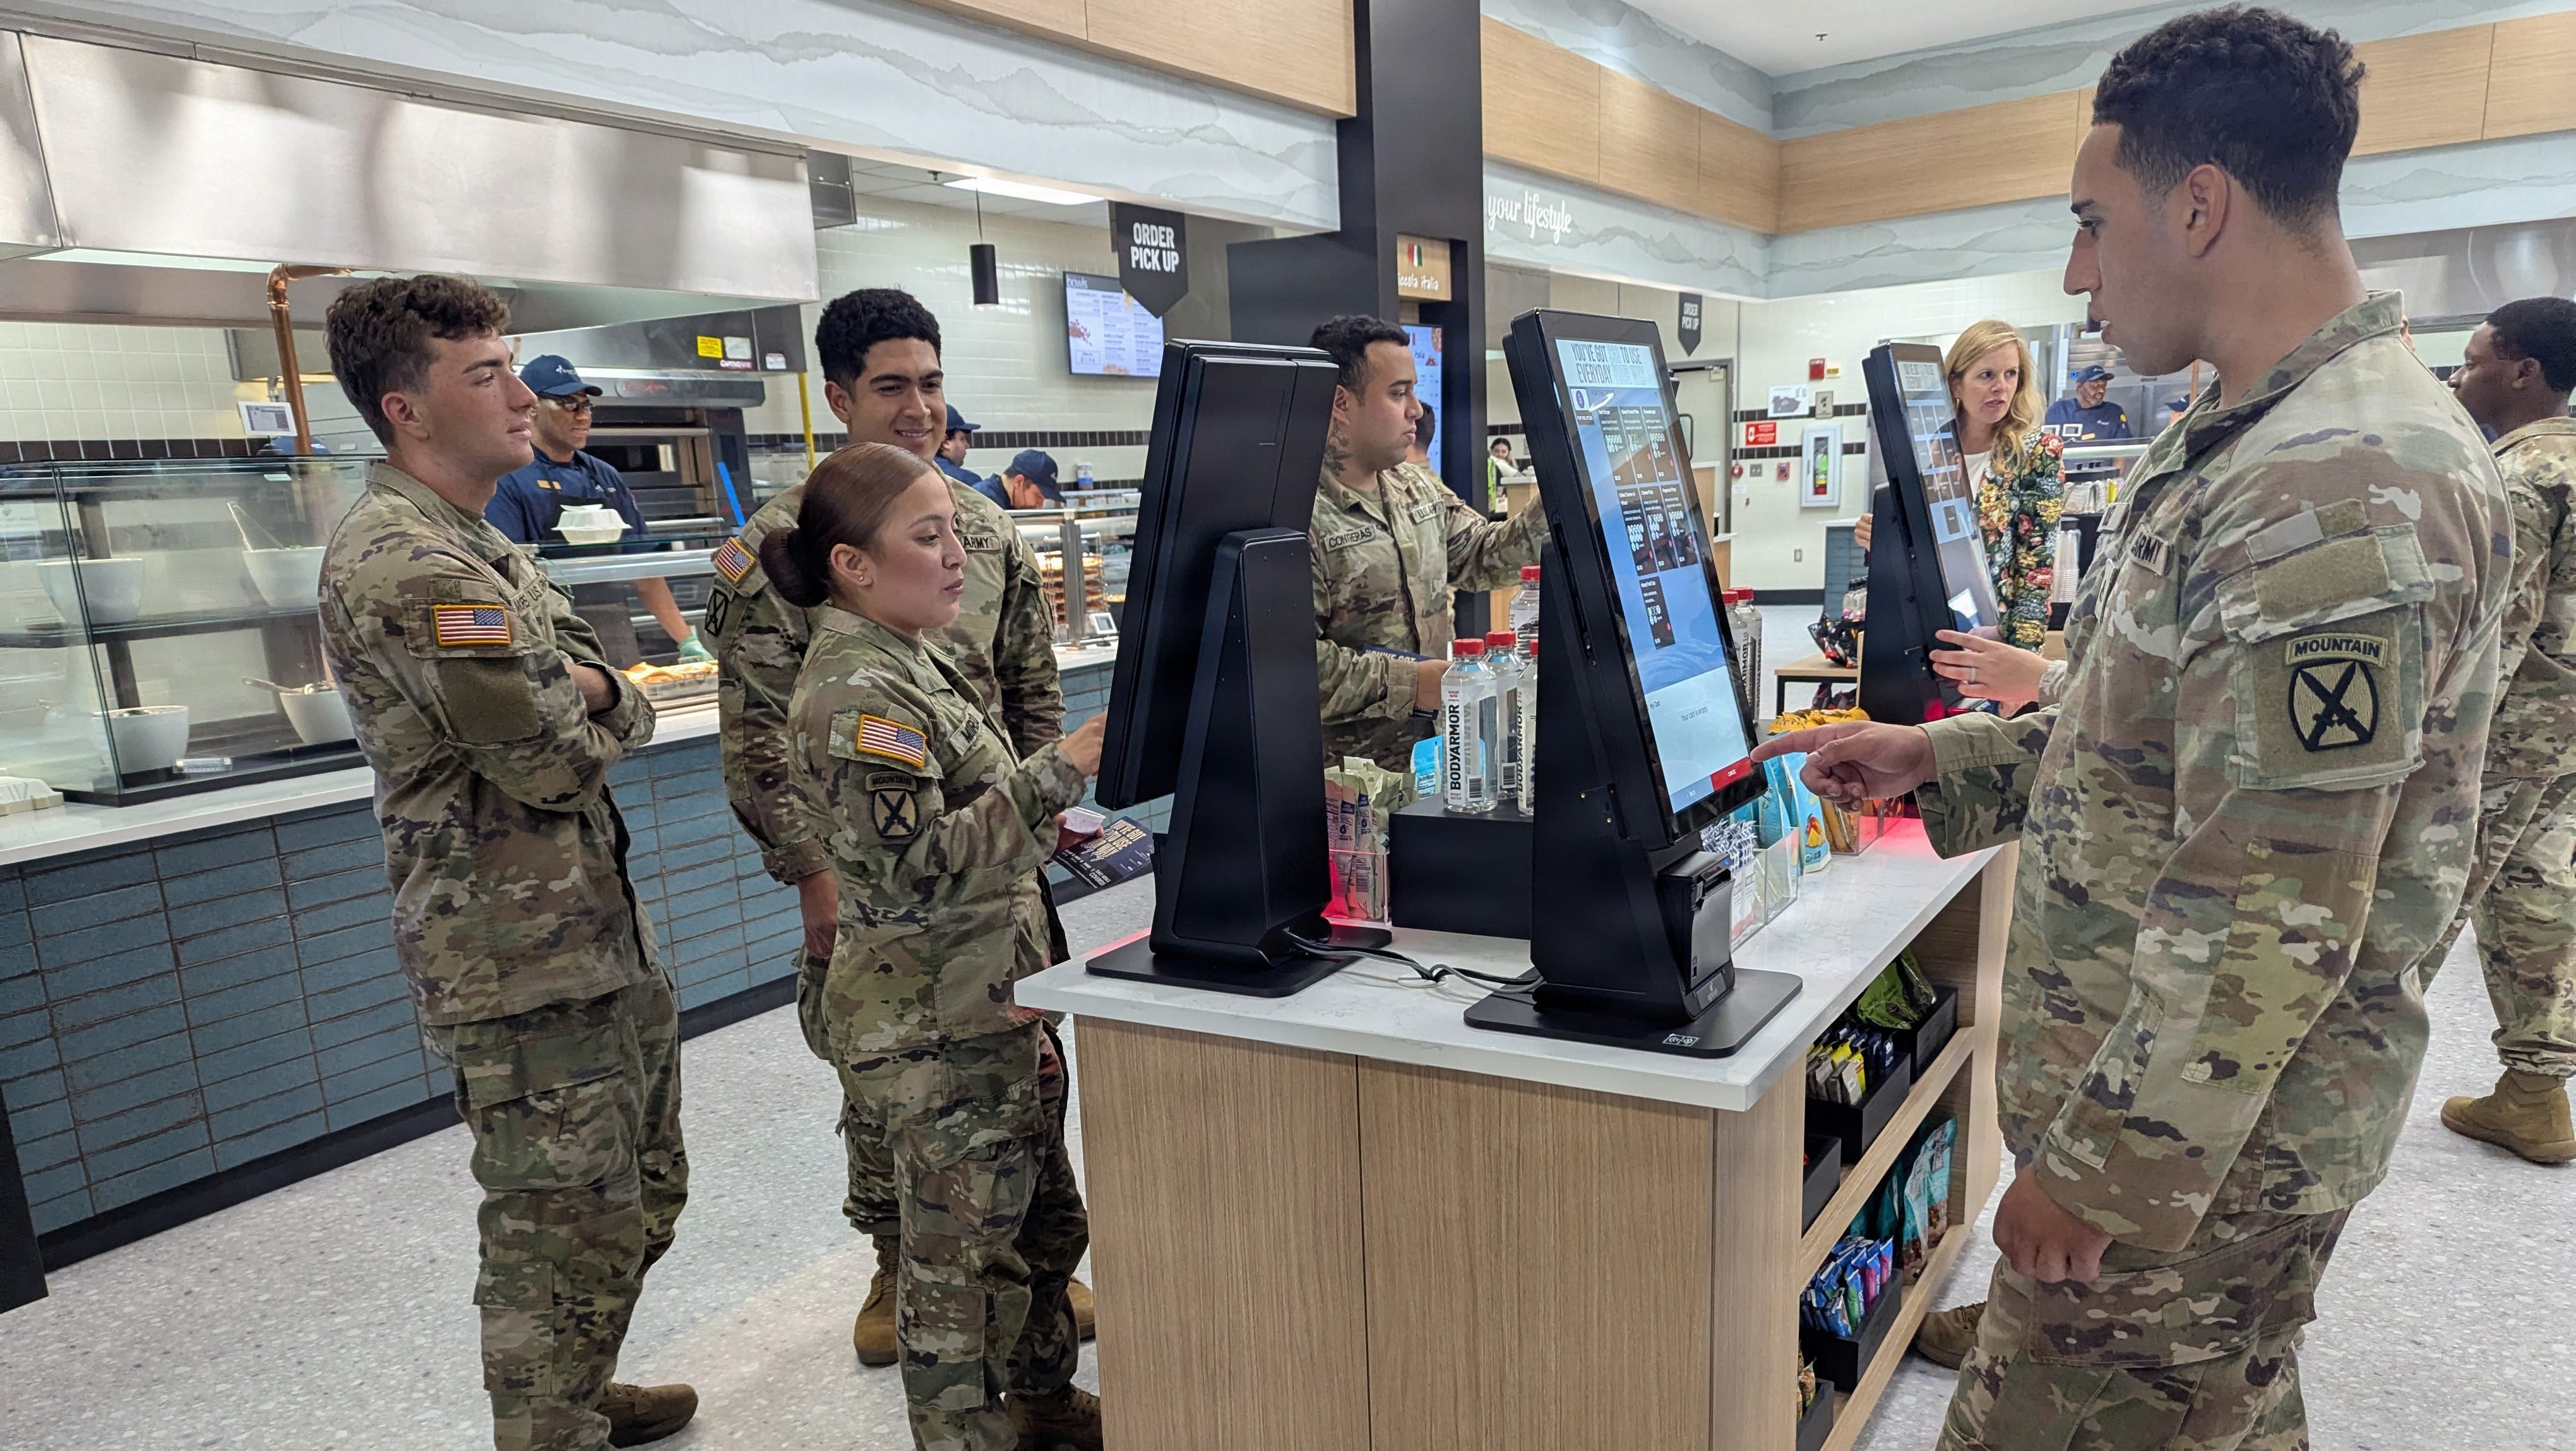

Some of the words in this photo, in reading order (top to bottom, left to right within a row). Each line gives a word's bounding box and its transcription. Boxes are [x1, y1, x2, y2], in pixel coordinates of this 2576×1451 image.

[1488, 195, 1521, 231] your
[1524, 191, 1571, 244] lifestyle
[1133, 222, 1175, 249] ORDER
[1130, 246, 1161, 271] PICK
[1162, 250, 1179, 273] UP
[1398, 272, 1418, 289] iccola
[1420, 274, 1439, 291] italia
[1683, 302, 1698, 316] ORDER
[1681, 316, 1692, 330] PICK
[1692, 318, 1699, 331] UP
[1570, 343, 1596, 362] YOU'VE
[1594, 345, 1608, 363] GOT
[1619, 346, 1630, 364] TO
[1628, 347, 1642, 364] USE
[1576, 362, 1613, 384] EVERYDAY
[963, 535, 989, 549] ARMY
[1328, 527, 1372, 548] CONTRERAS
[2131, 532, 2164, 564] ARMY
[2294, 638, 2380, 658] MOUNTAIN
[1448, 704, 1462, 791] BODYARMOR
[1126, 828, 1147, 842] GOT
